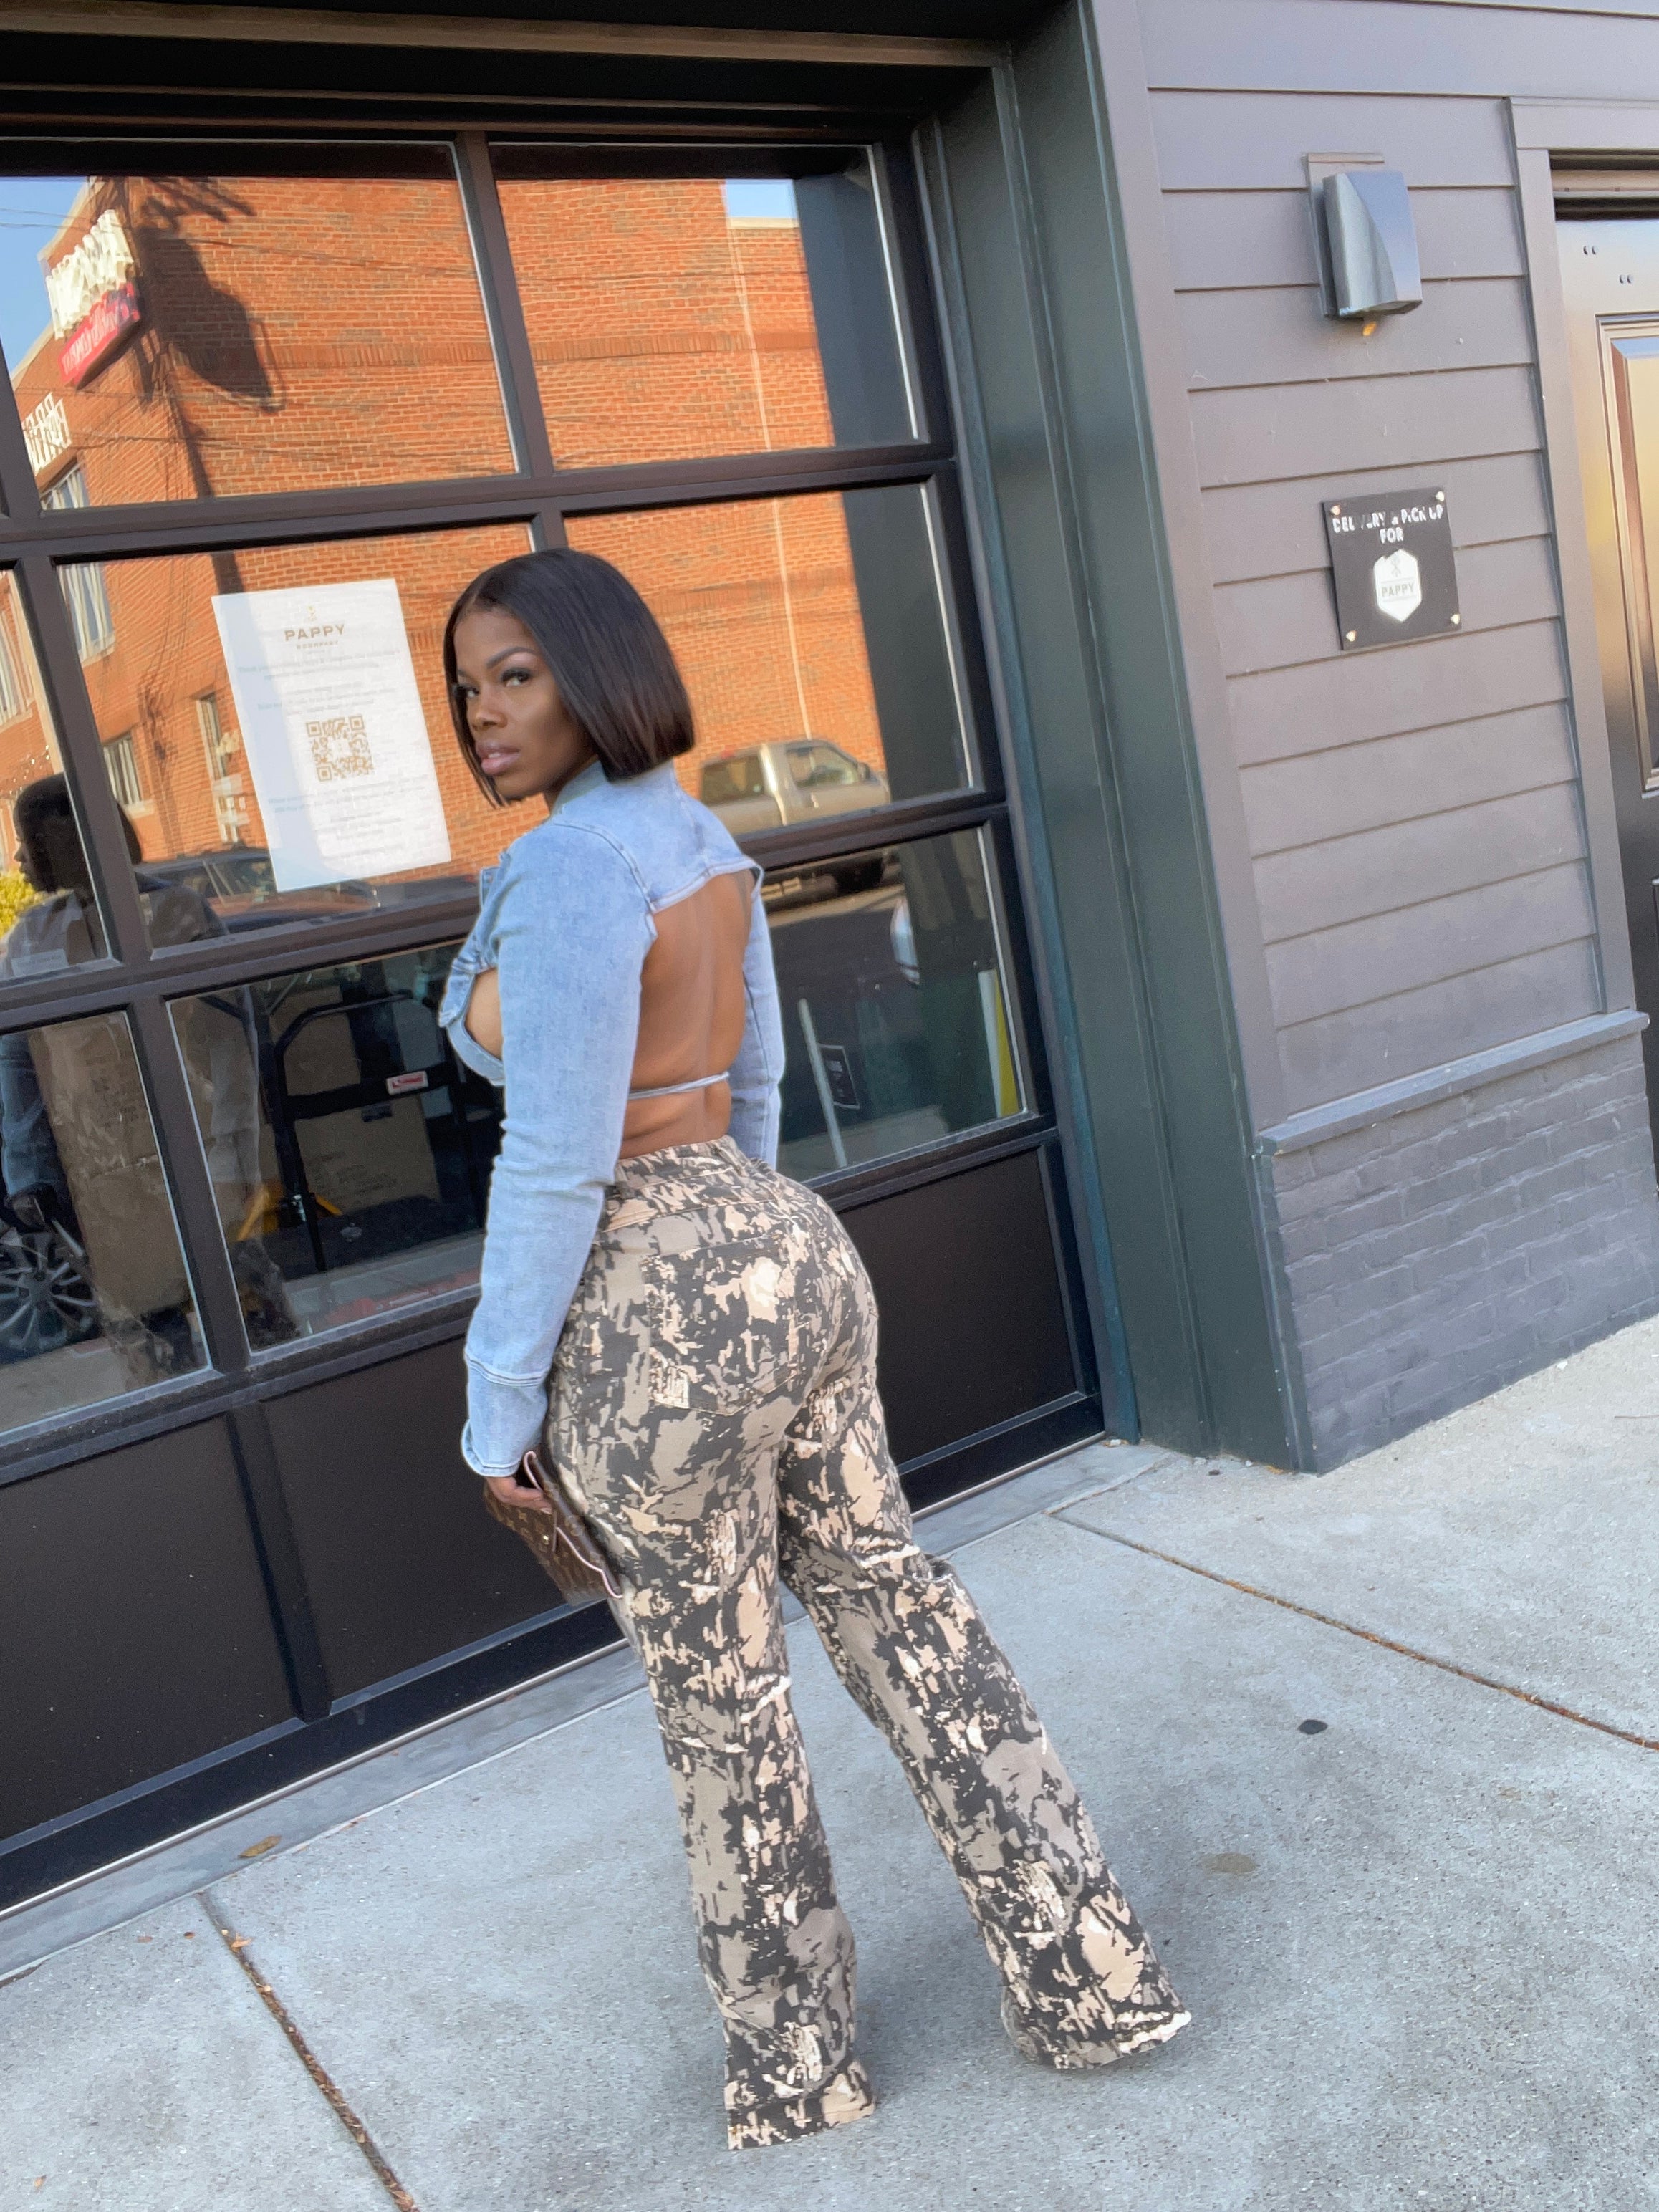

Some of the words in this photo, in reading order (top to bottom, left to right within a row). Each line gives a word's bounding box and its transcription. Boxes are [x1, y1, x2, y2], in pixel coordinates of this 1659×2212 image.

[1332, 511, 1386, 533] DELRY
[1429, 504, 1443, 520] UP
[1380, 526, 1404, 544] FOR
[1381, 582, 1415, 597] PAPPY
[284, 624, 345, 642] PAPPY
